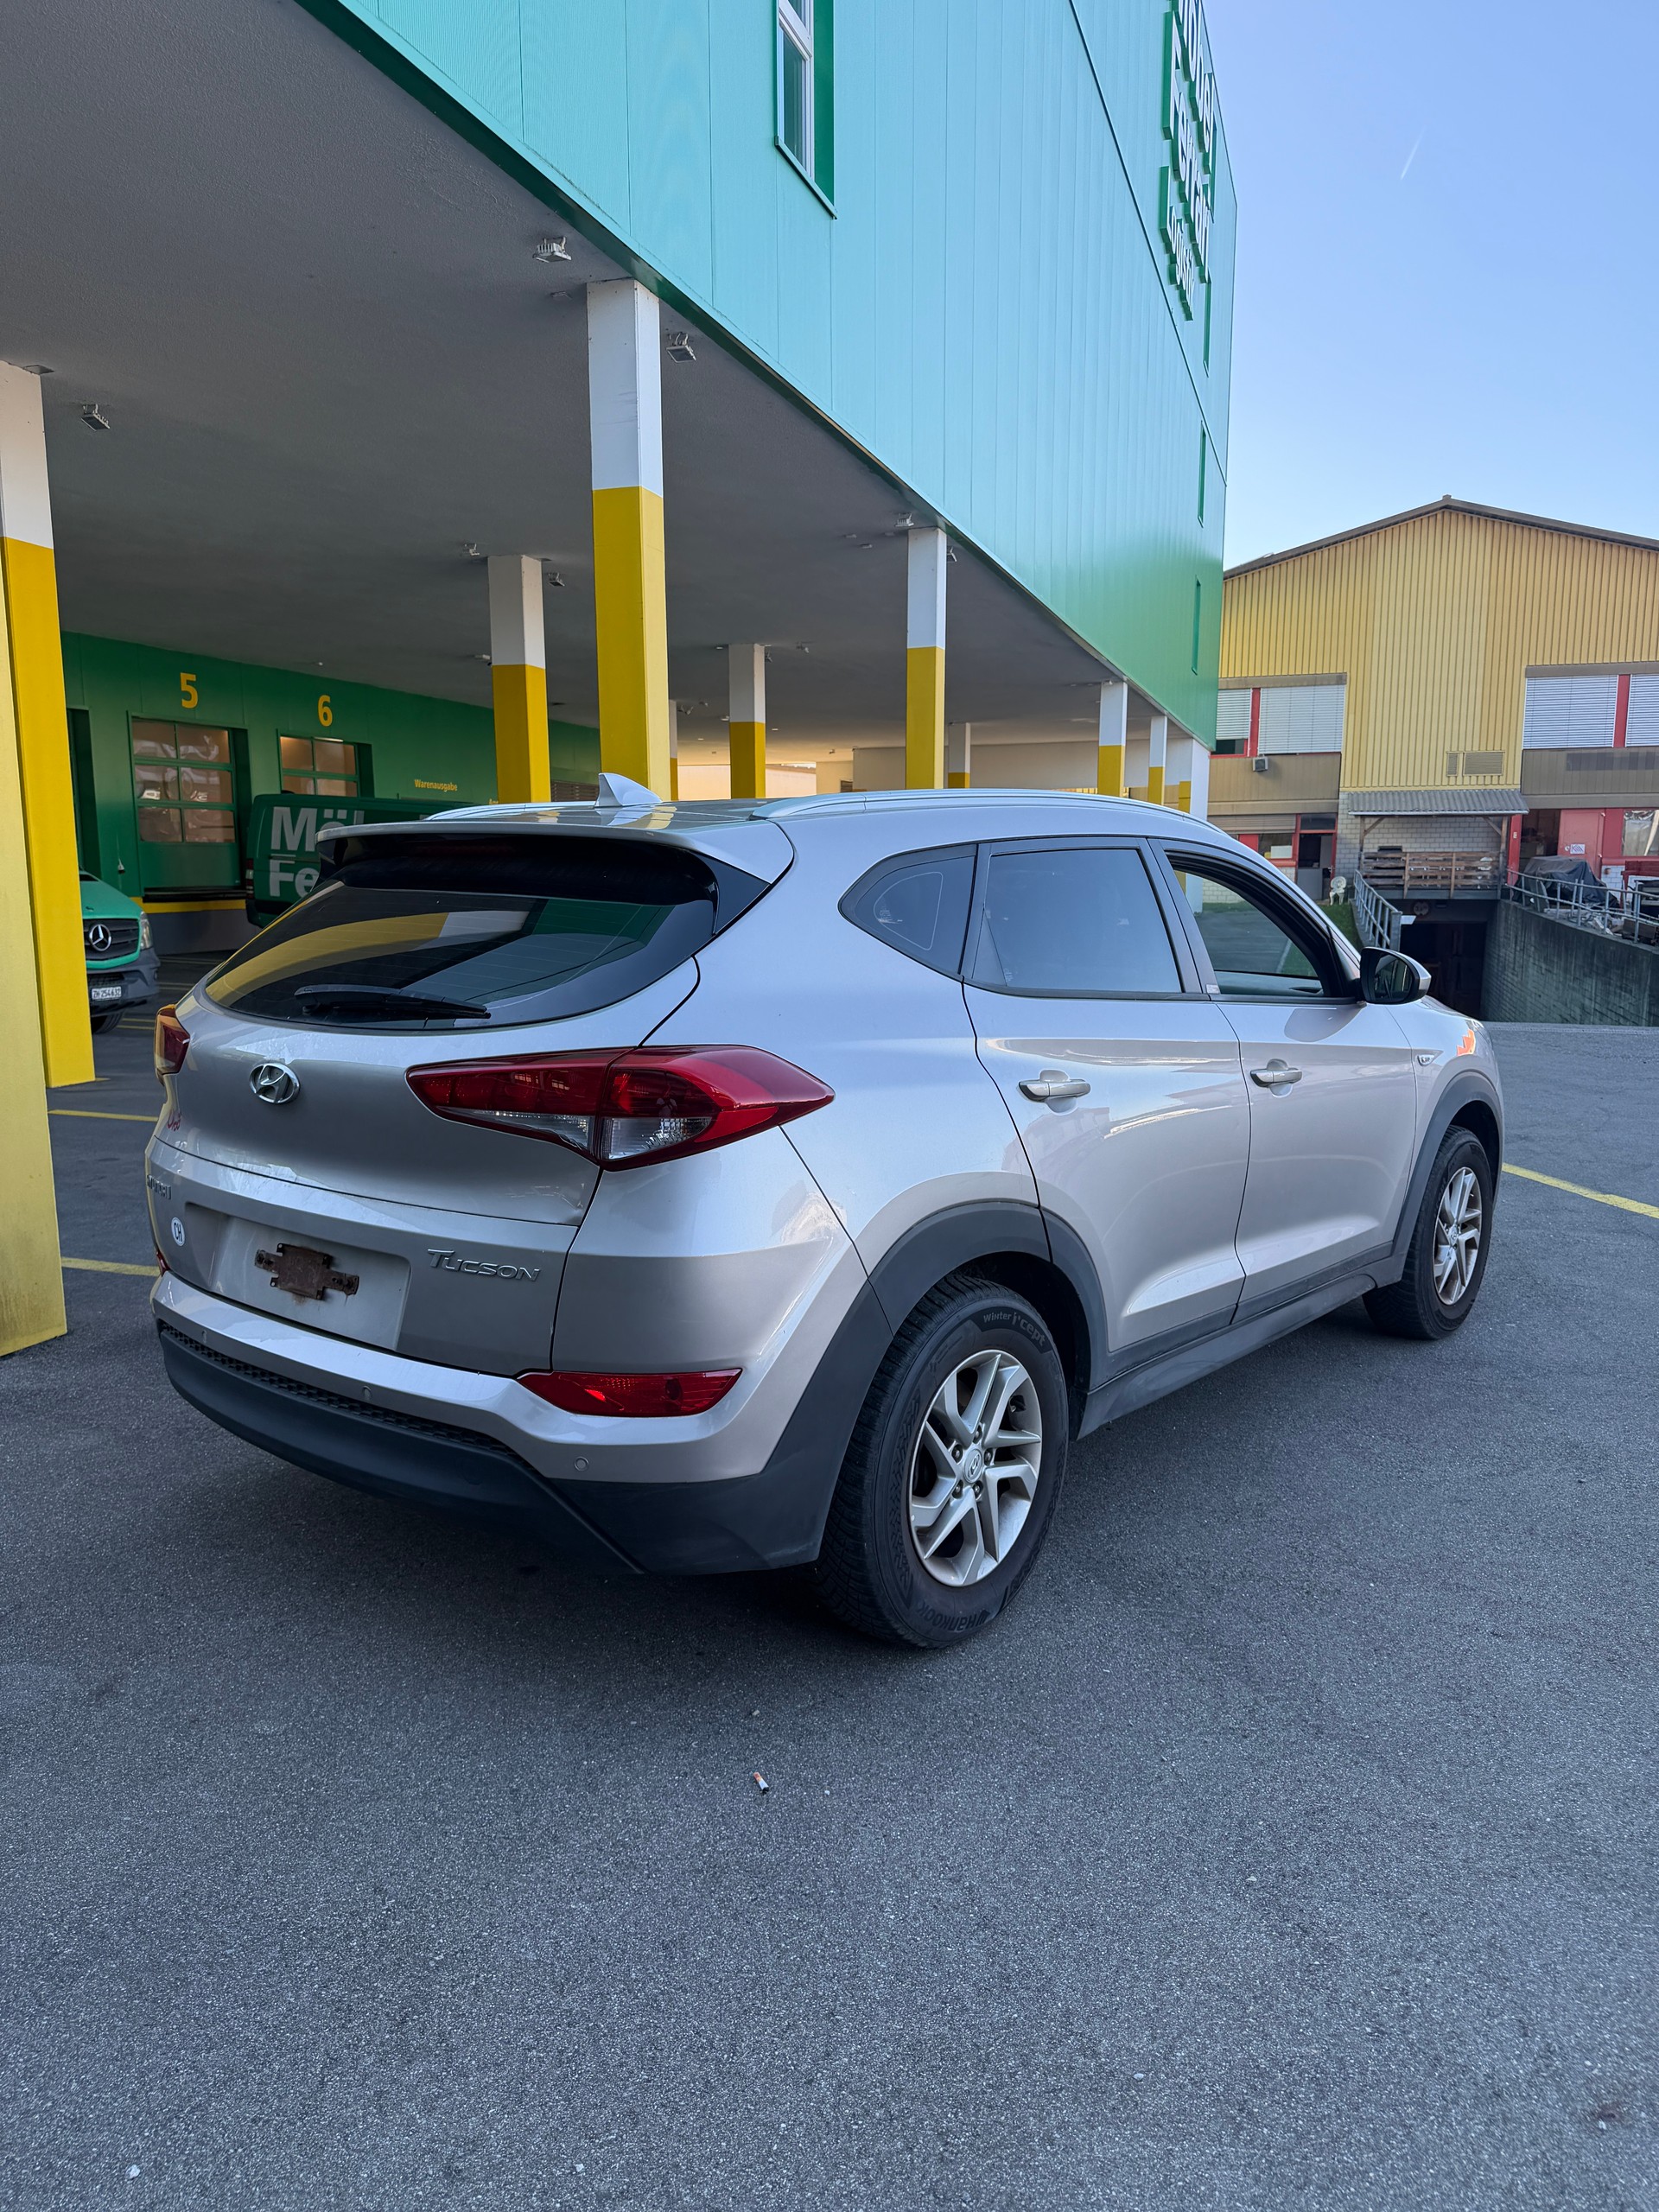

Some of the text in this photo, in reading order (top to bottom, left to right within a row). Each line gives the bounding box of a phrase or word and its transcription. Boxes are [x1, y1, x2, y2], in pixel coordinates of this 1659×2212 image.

[1164, 10, 1211, 283] Ferrari
[1162, 165, 1194, 321] Logistik
[180, 671, 199, 709] 5
[317, 694, 334, 727] 6
[415, 779, 458, 792] Warenausgabe
[174, 1223, 183, 1242] CH
[983, 1311, 1012, 1324] Winter
